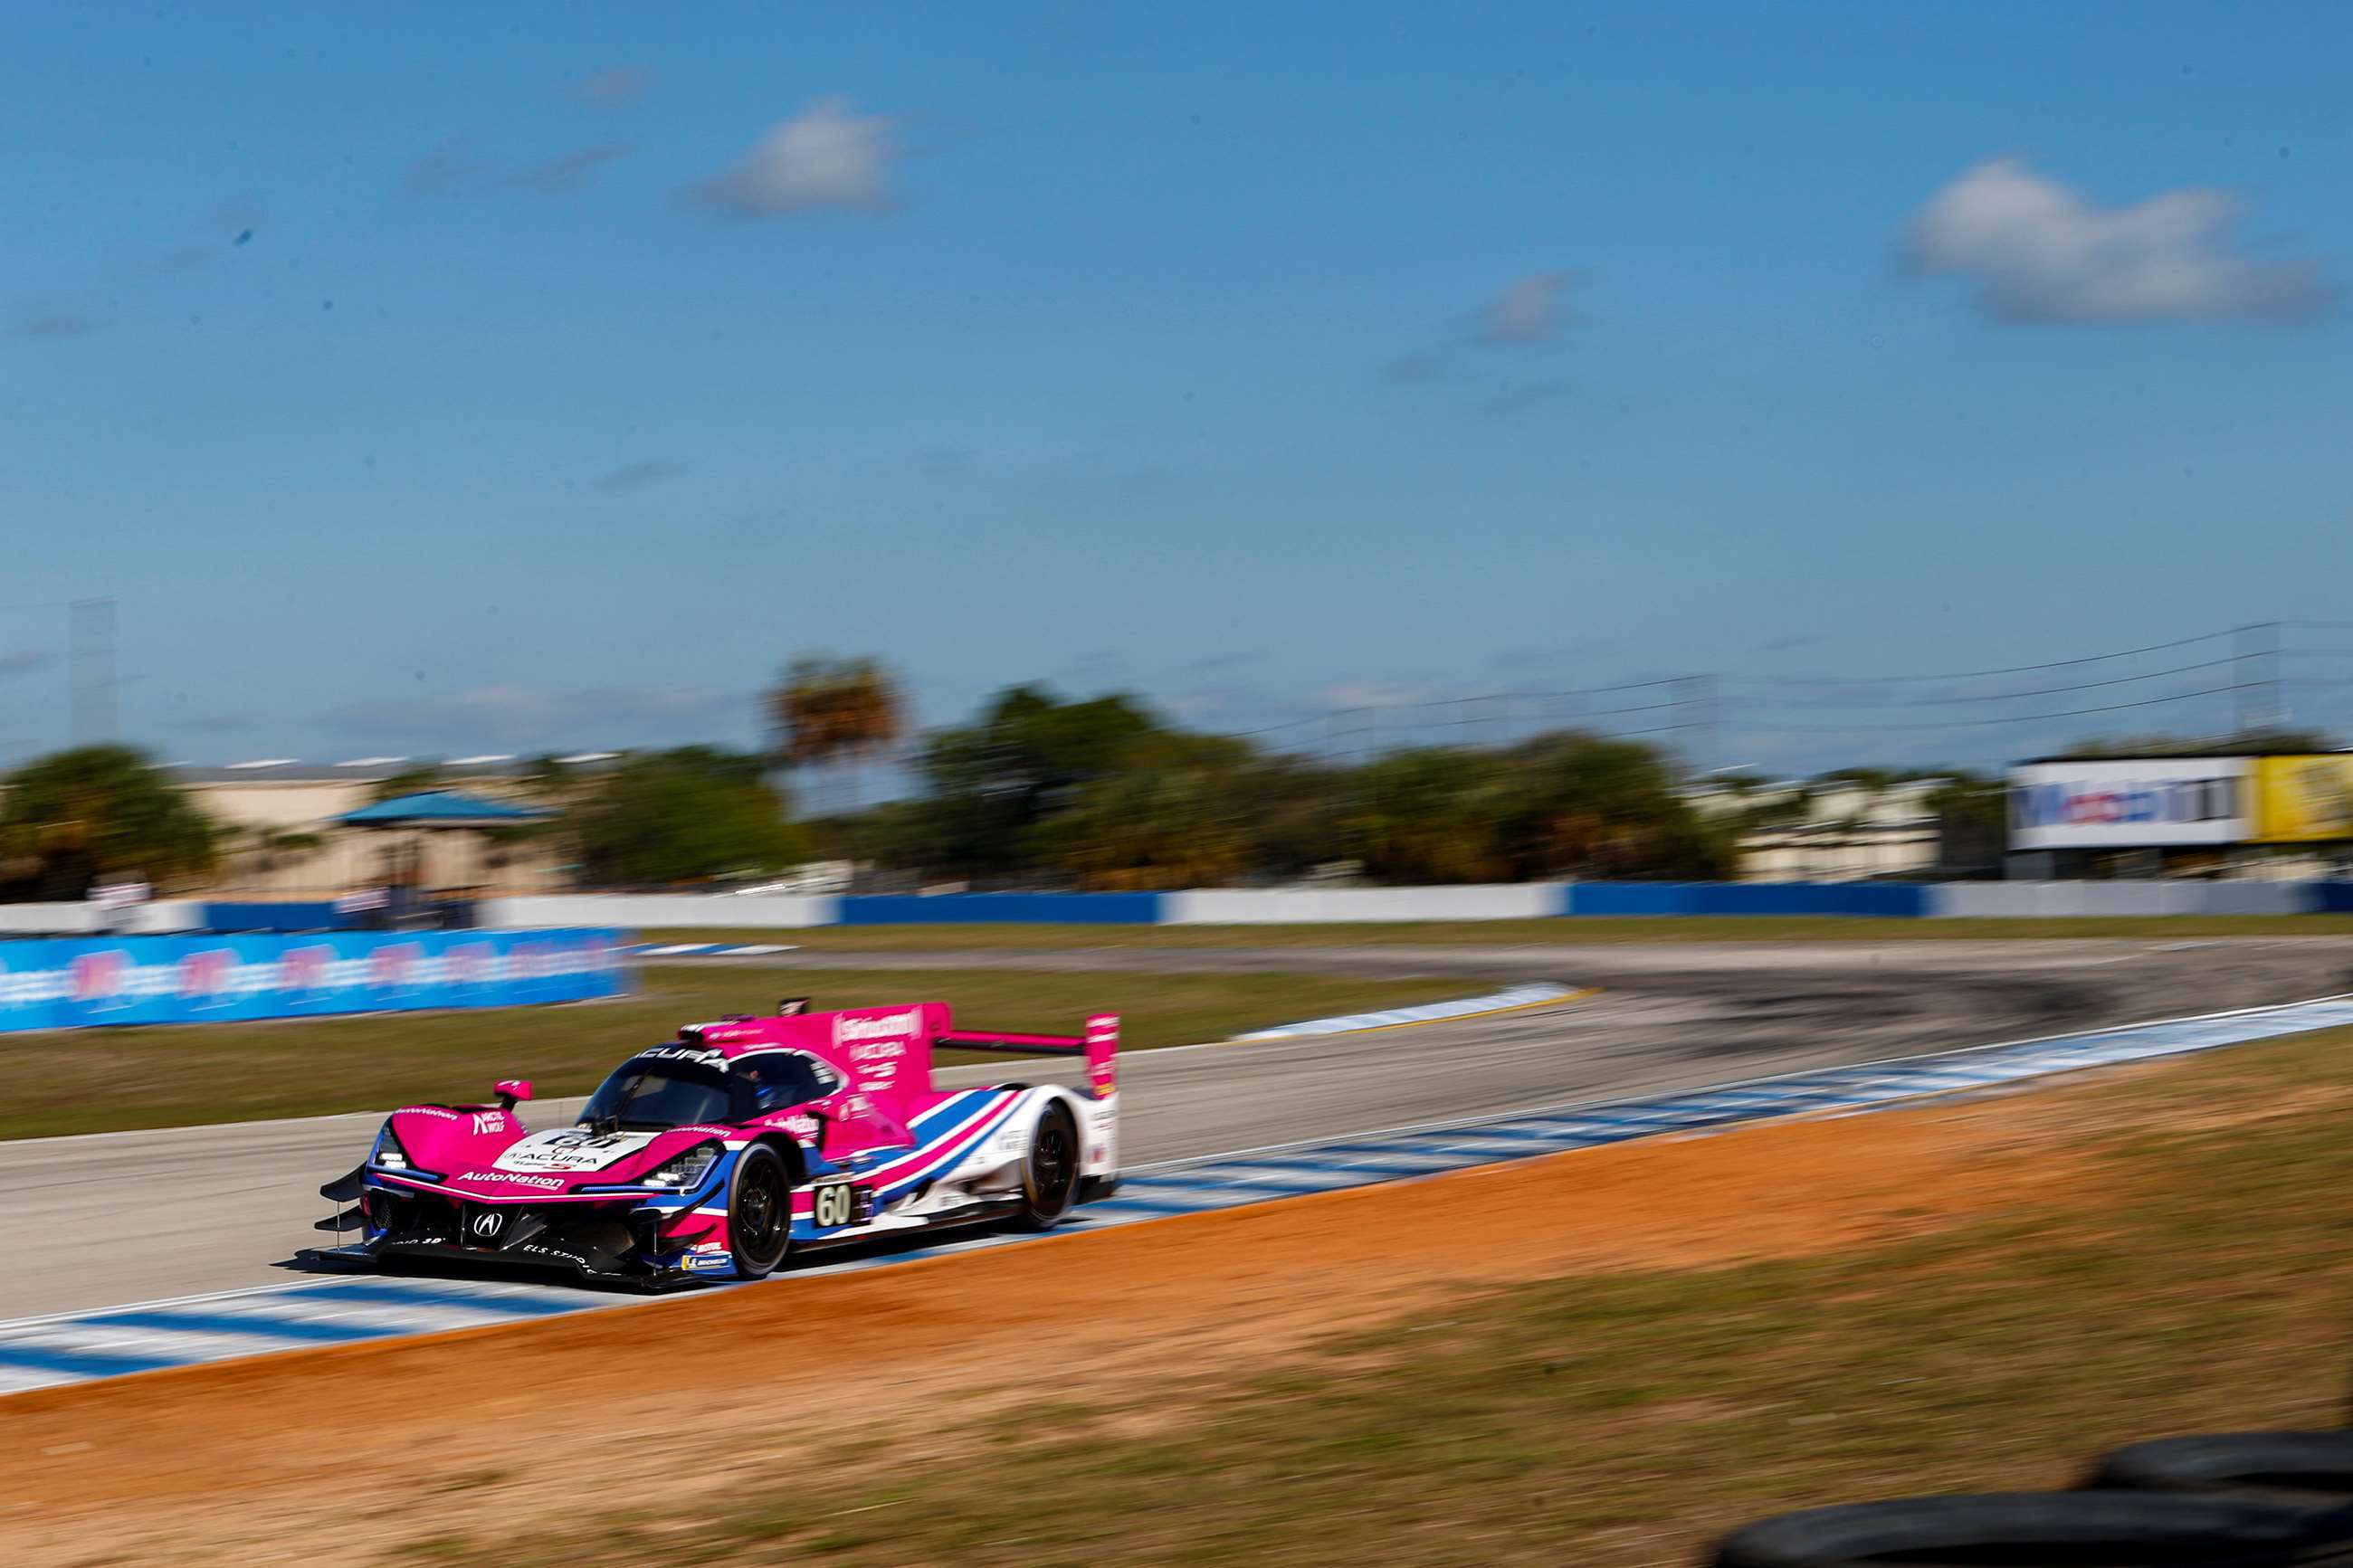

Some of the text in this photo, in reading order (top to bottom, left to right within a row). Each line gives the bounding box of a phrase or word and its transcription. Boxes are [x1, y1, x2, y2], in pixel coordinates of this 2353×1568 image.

[519, 1154, 597, 1164] ACURA
[457, 1171, 566, 1188] AutoNation
[816, 1184, 851, 1226] 60
[523, 1244, 548, 1254] ELS
